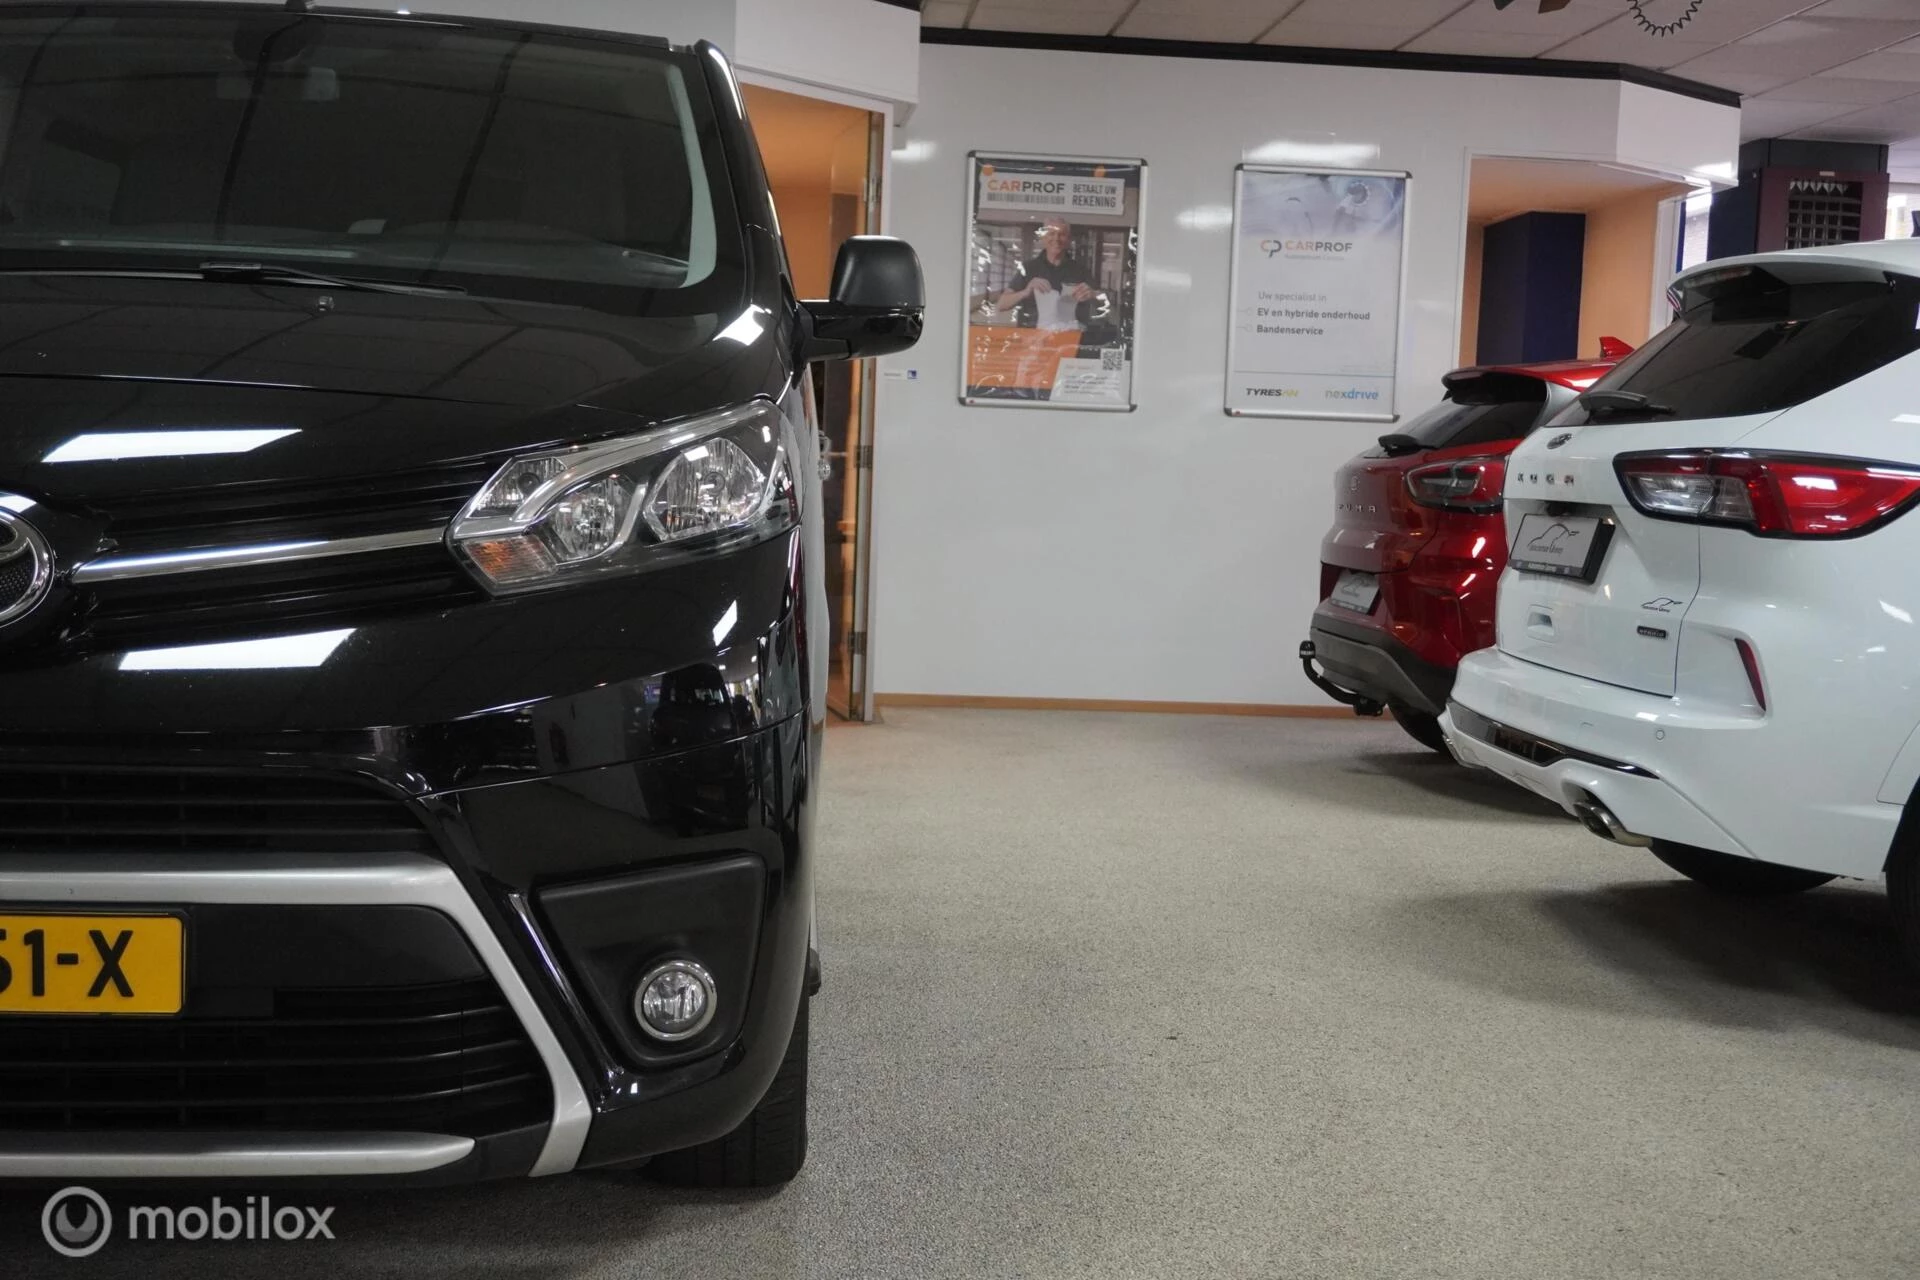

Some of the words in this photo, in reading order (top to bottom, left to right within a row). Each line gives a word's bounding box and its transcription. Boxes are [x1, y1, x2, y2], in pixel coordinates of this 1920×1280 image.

[987, 179, 1065, 194] CARPROF
[1072, 183, 1103, 195] BETAALT
[1104, 185, 1117, 195] UW
[1072, 195, 1117, 208] REKENING
[1285, 240, 1353, 253] CARPROF
[1258, 291, 1273, 300] Uw
[1275, 291, 1316, 303] specialist
[1318, 293, 1327, 302] in
[1257, 307, 1270, 317] EV
[1271, 310, 1283, 318] en
[1285, 309, 1320, 320] hybride
[1321, 311, 1371, 321] onderhoud
[1256, 324, 1324, 336] Bandenservice
[1325, 387, 1379, 400] nexdrive
